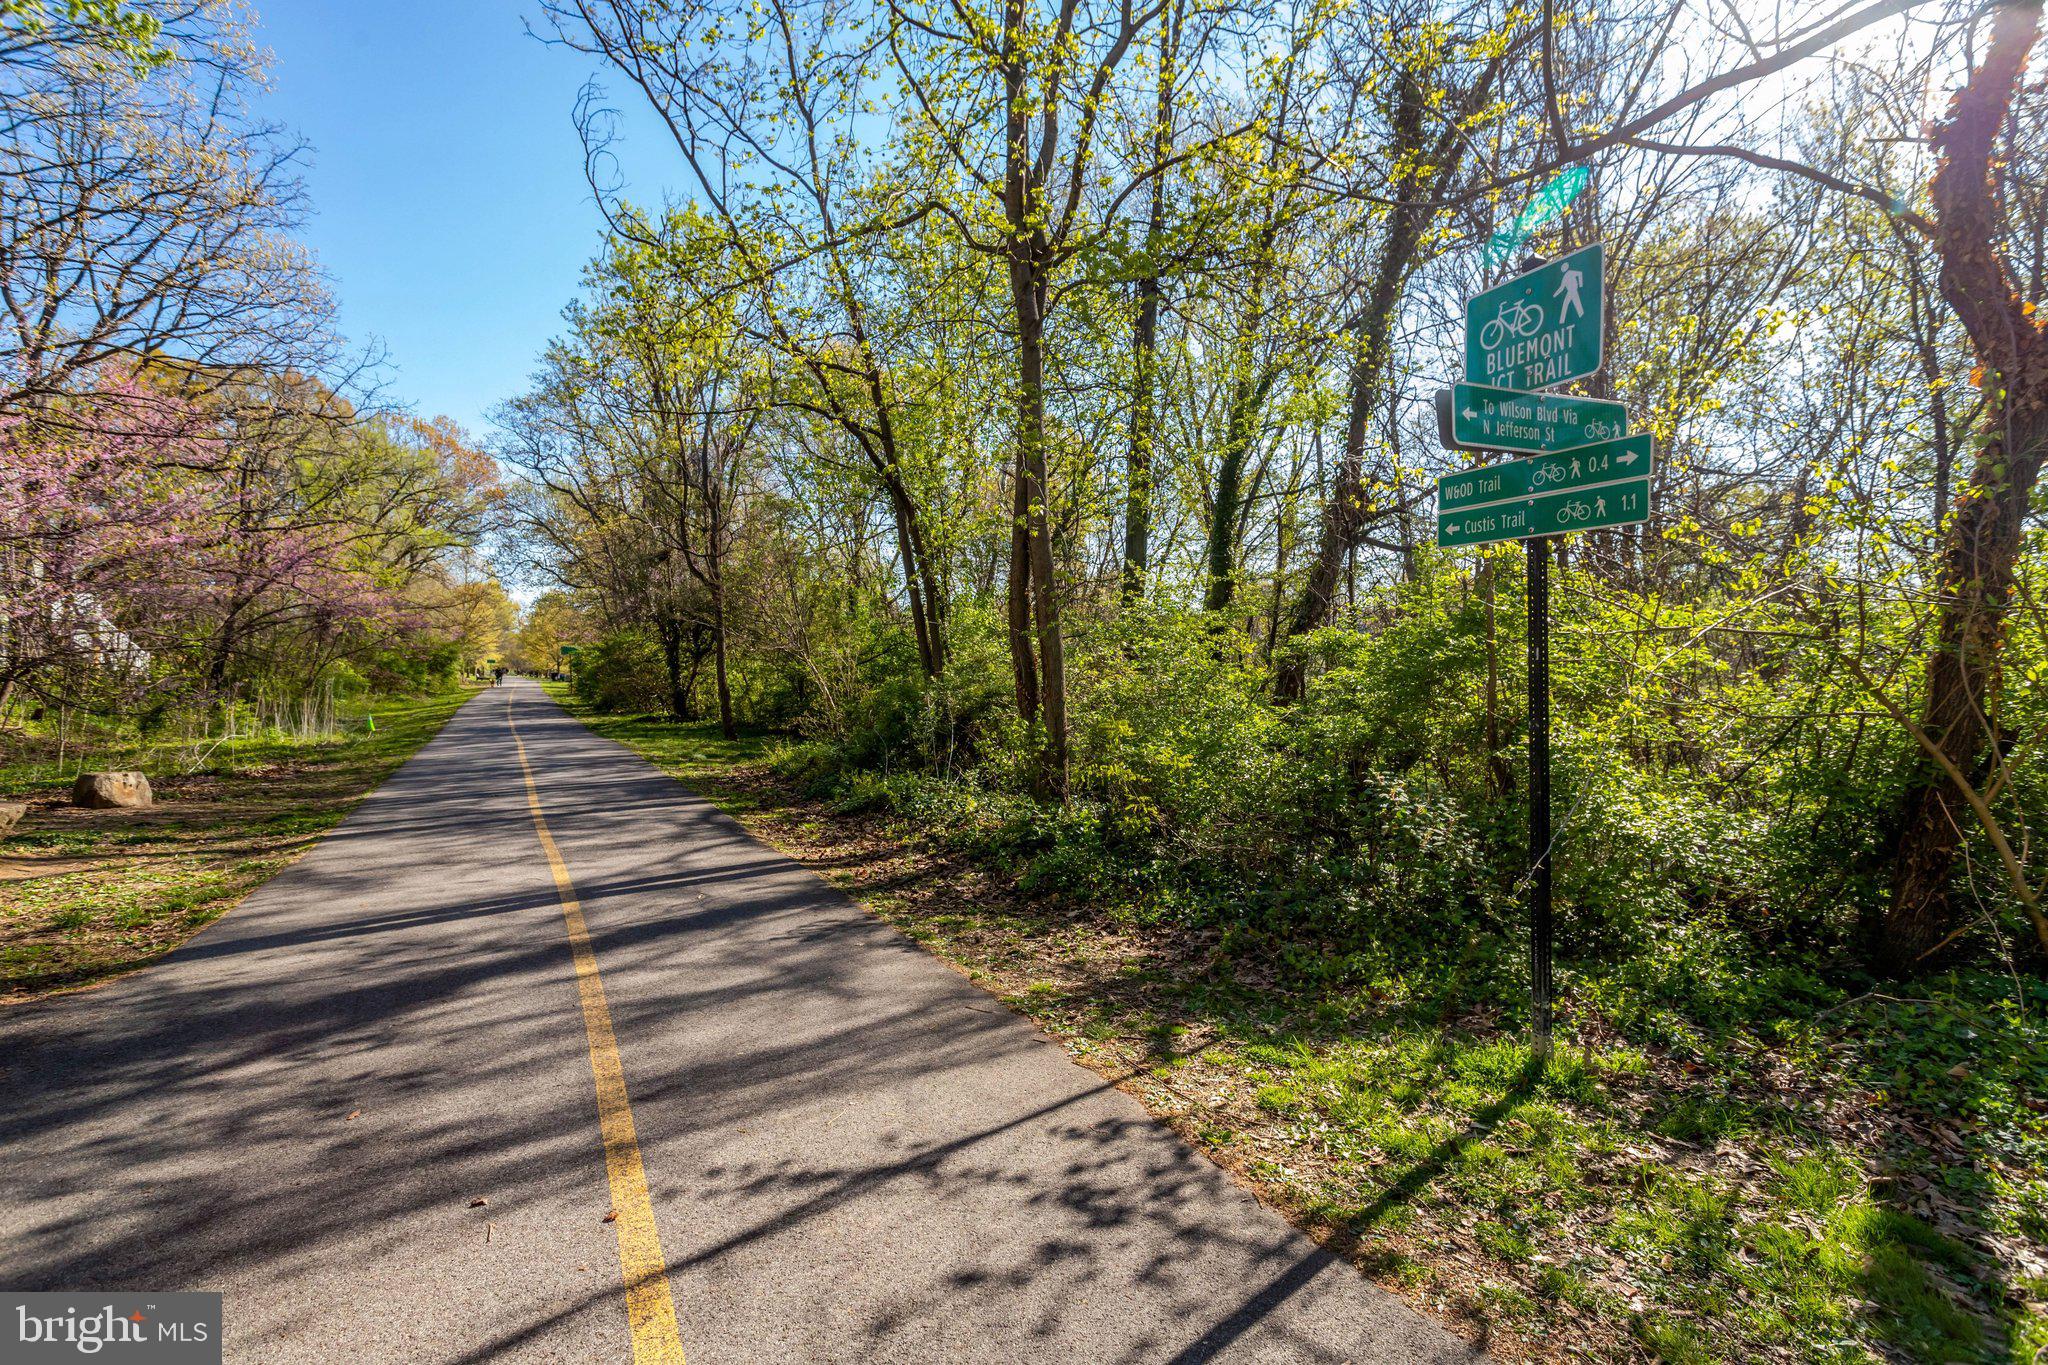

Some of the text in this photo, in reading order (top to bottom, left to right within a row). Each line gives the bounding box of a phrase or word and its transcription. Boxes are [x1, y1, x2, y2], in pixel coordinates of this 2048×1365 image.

[1487, 324, 1575, 375] BLUEMONT
[1525, 353, 1572, 387] TRAIL
[1483, 399, 1578, 425] To Wilson Blvd Via
[1483, 419, 1555, 442] N Jefferson St
[1445, 454, 1609, 500] W&OD Trail 0.4
[1464, 493, 1636, 534] Custis Trail 1.1
